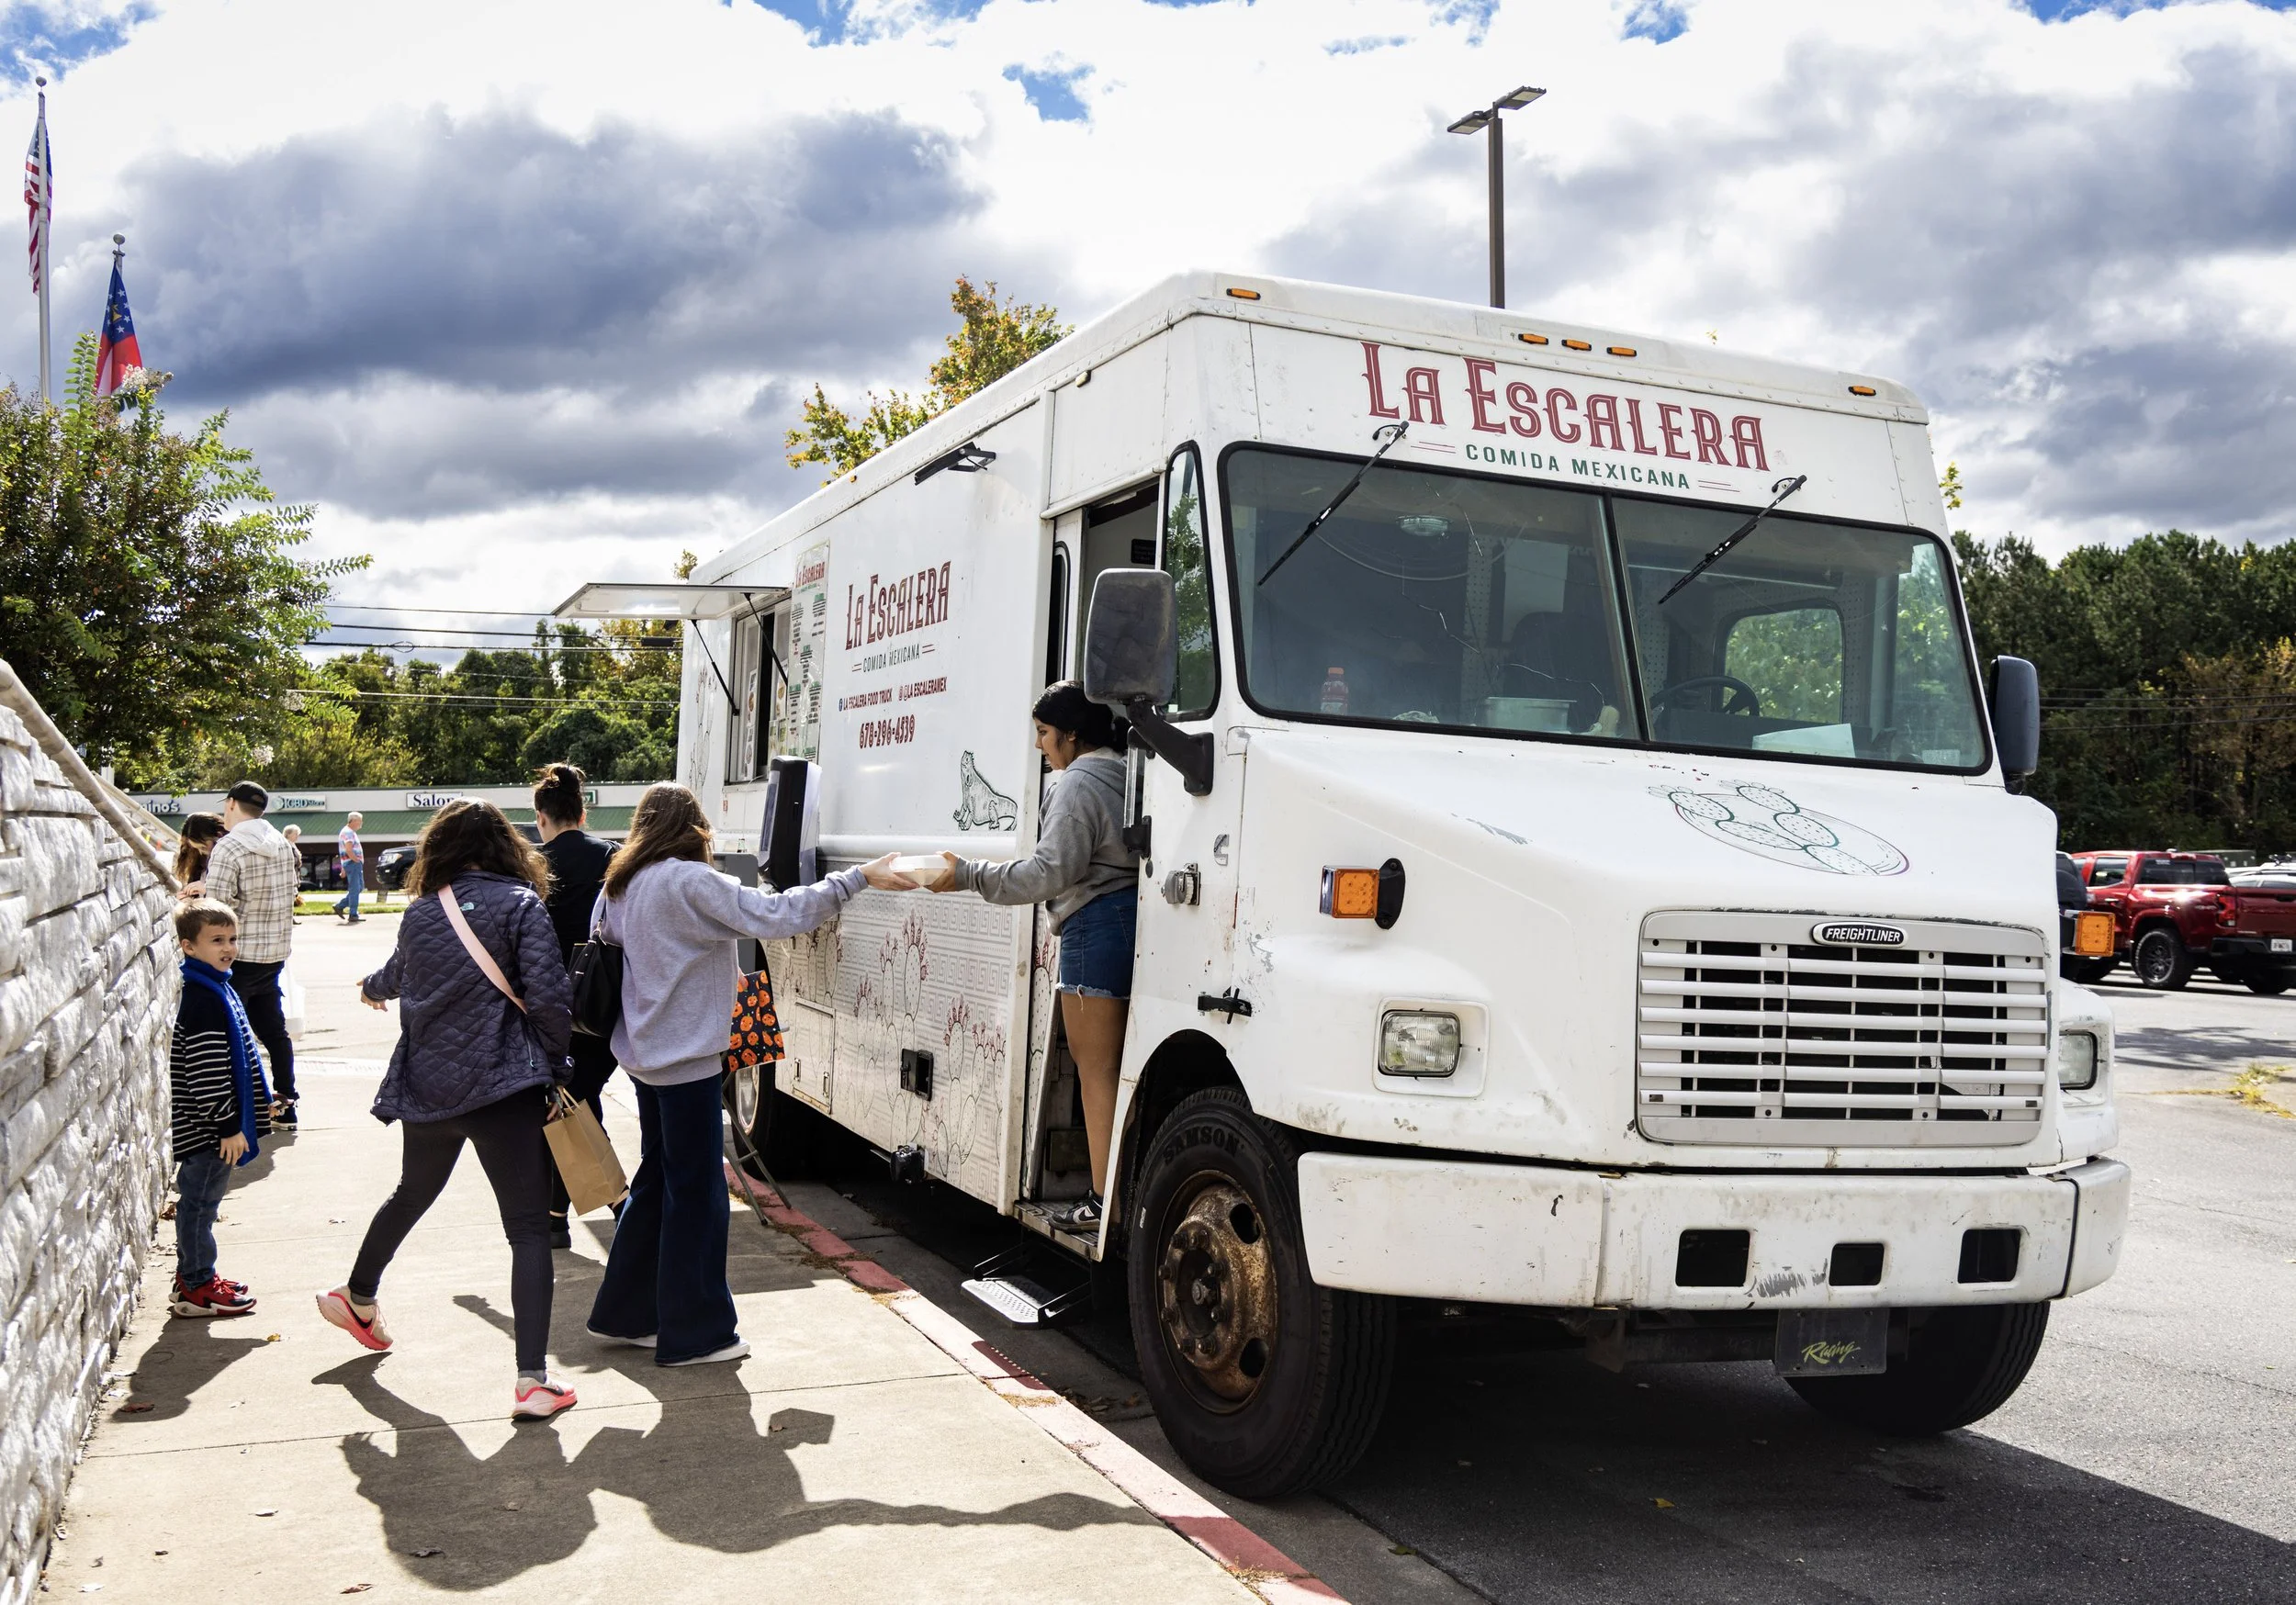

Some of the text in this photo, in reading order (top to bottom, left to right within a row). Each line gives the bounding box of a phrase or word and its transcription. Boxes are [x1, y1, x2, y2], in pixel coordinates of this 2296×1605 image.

[1359, 341, 1771, 472] LA ESCALERA
[1465, 443, 1690, 489] COMIDA MEXICANA
[845, 583, 865, 650] LA
[866, 560, 951, 644] ESCALERA
[862, 643, 920, 672] COMIDA MEXICANA
[849, 693, 867, 709] ESCALERA
[867, 691, 879, 706] FOOD
[879, 688, 893, 703] TRUCK
[1825, 927, 1901, 942] FREIGHTLINER
[1162, 1126, 1240, 1166] SAMSON
[1801, 1341, 1862, 1364] Racing
